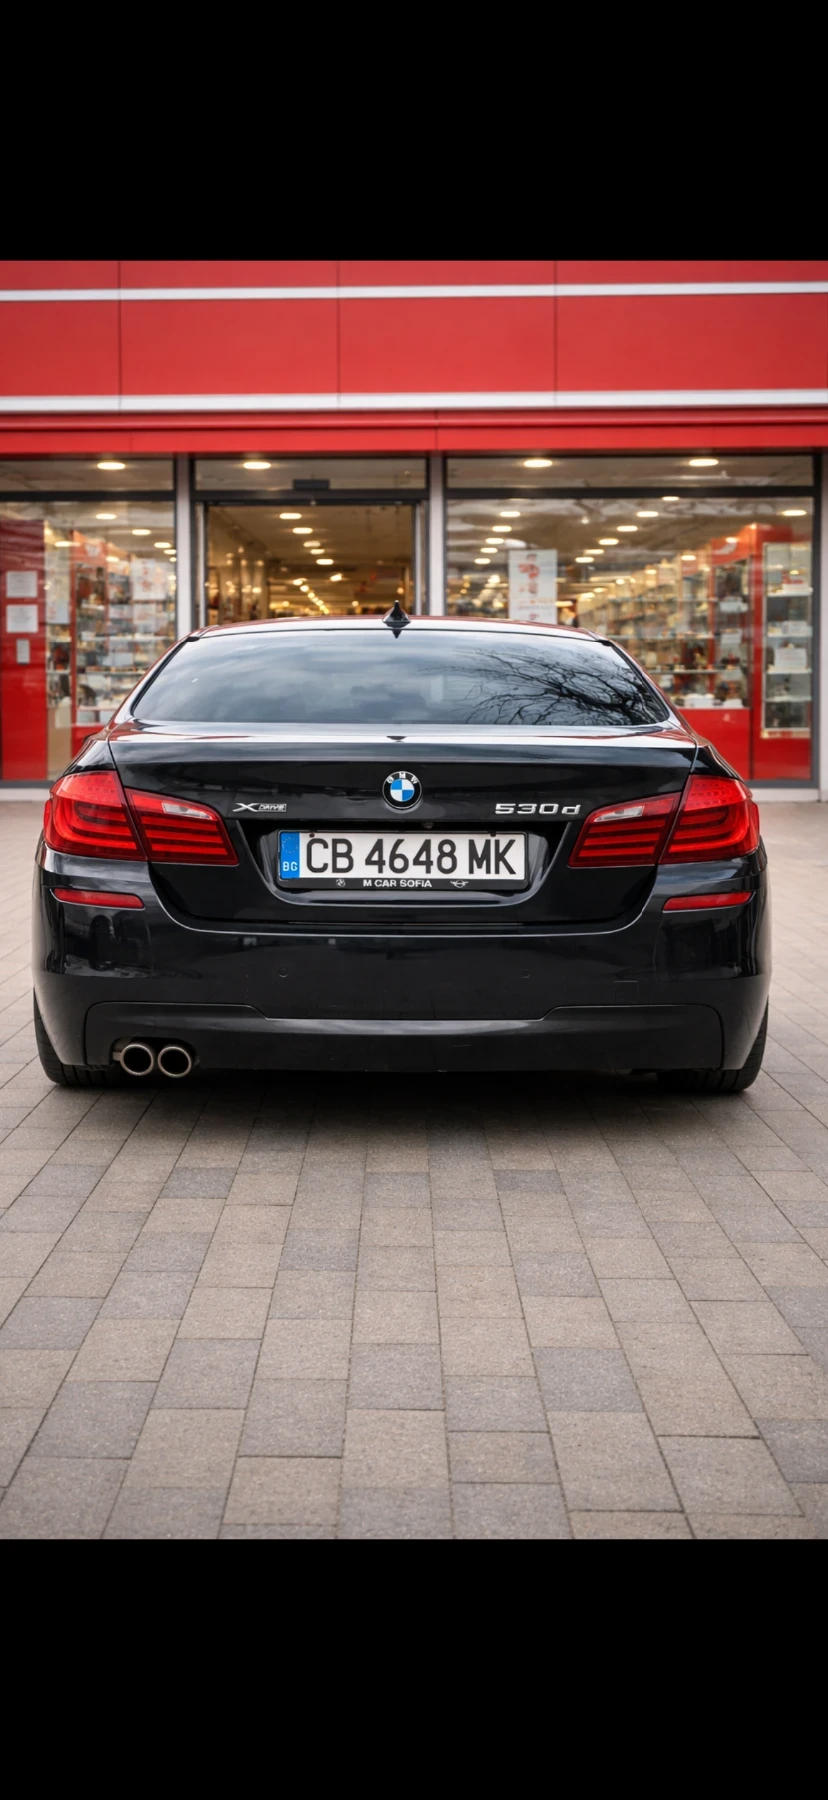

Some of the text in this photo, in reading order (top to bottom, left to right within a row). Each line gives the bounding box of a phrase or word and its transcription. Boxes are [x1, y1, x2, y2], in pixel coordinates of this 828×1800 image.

[495, 803, 582, 815] 530d
[306, 838, 516, 875] CB 4648 MK
[282, 861, 298, 872] BG
[363, 879, 432, 888] M CAR SOFIA
